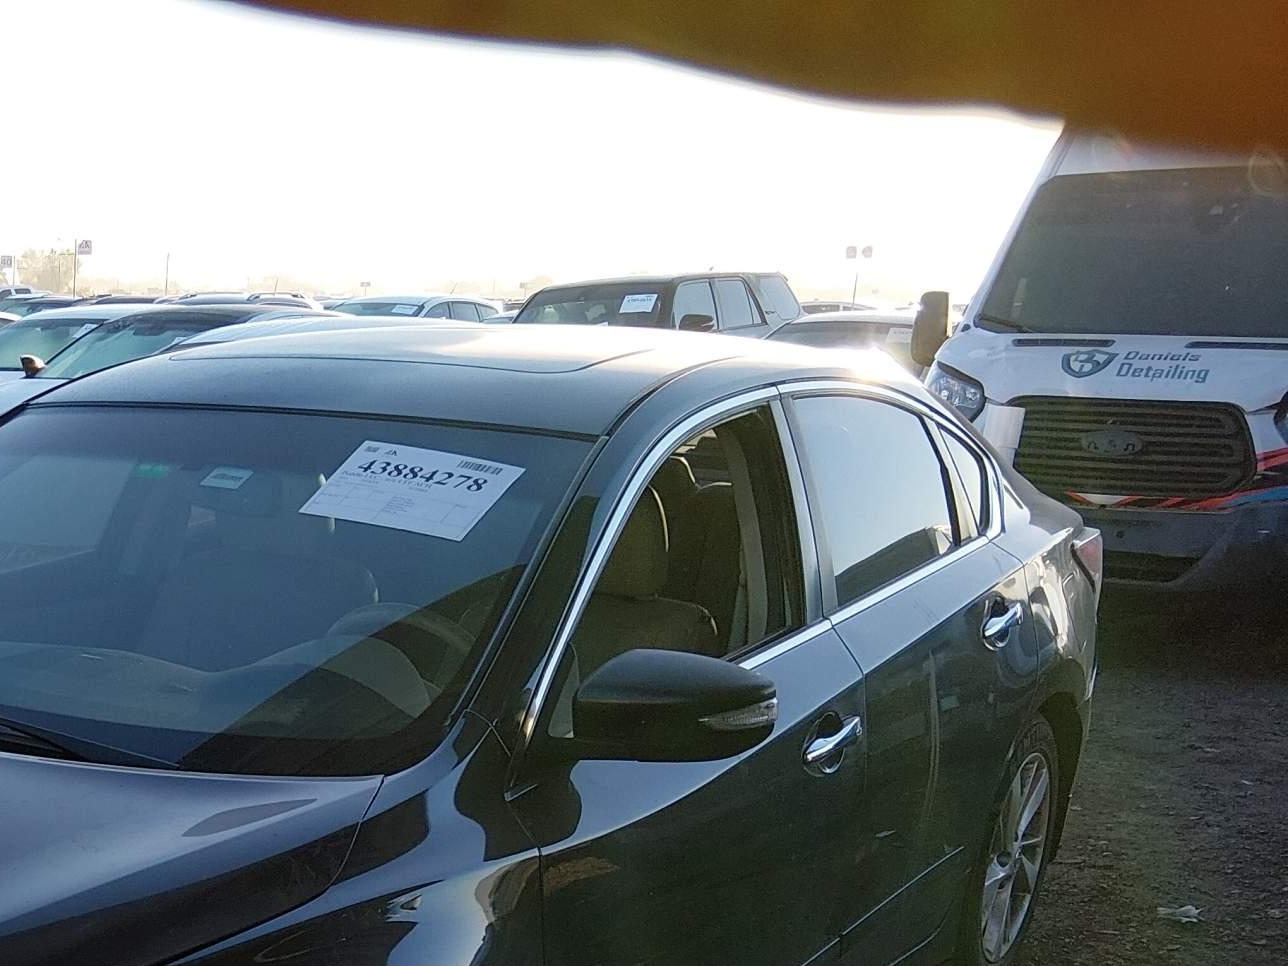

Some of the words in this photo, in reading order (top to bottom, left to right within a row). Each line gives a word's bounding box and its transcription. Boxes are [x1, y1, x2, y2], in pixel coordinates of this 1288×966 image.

[1123, 351, 1202, 362] Daniels
[1115, 362, 1210, 383] Detailing
[358, 459, 488, 492] 43884278
